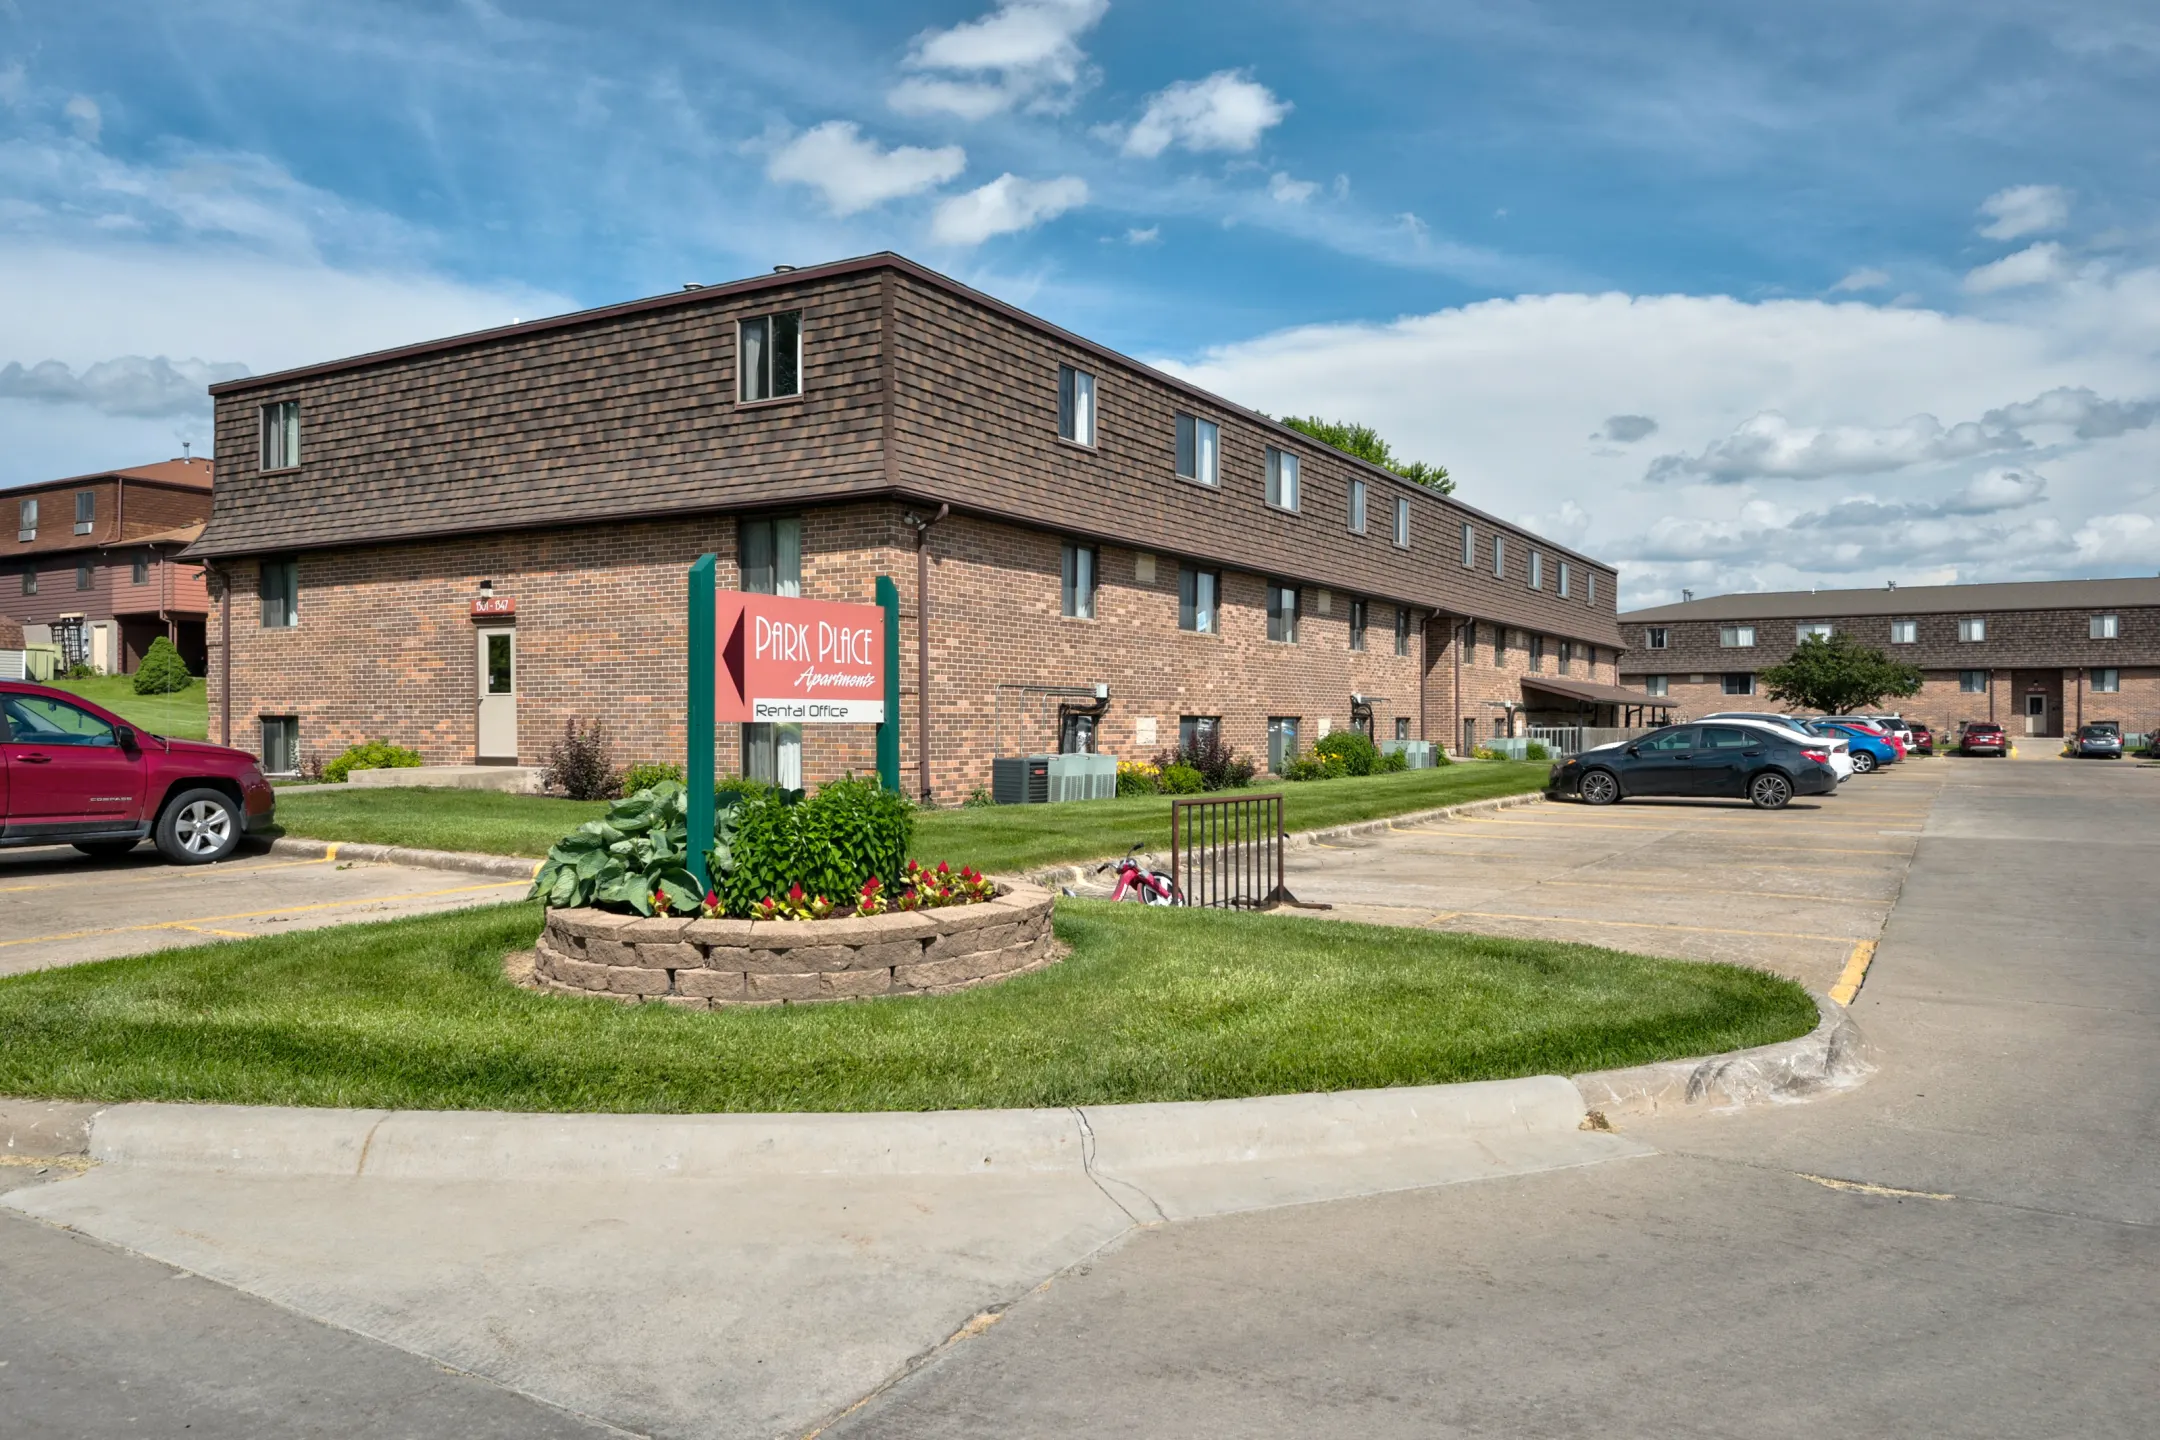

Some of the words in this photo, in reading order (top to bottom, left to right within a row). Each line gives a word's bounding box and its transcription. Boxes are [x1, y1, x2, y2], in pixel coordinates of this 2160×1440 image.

[755, 615, 811, 662] PARK
[819, 621, 873, 665] PLACE
[793, 665, 876, 693] Apartments
[755, 704, 806, 718] Rental
[809, 704, 849, 718] Office
